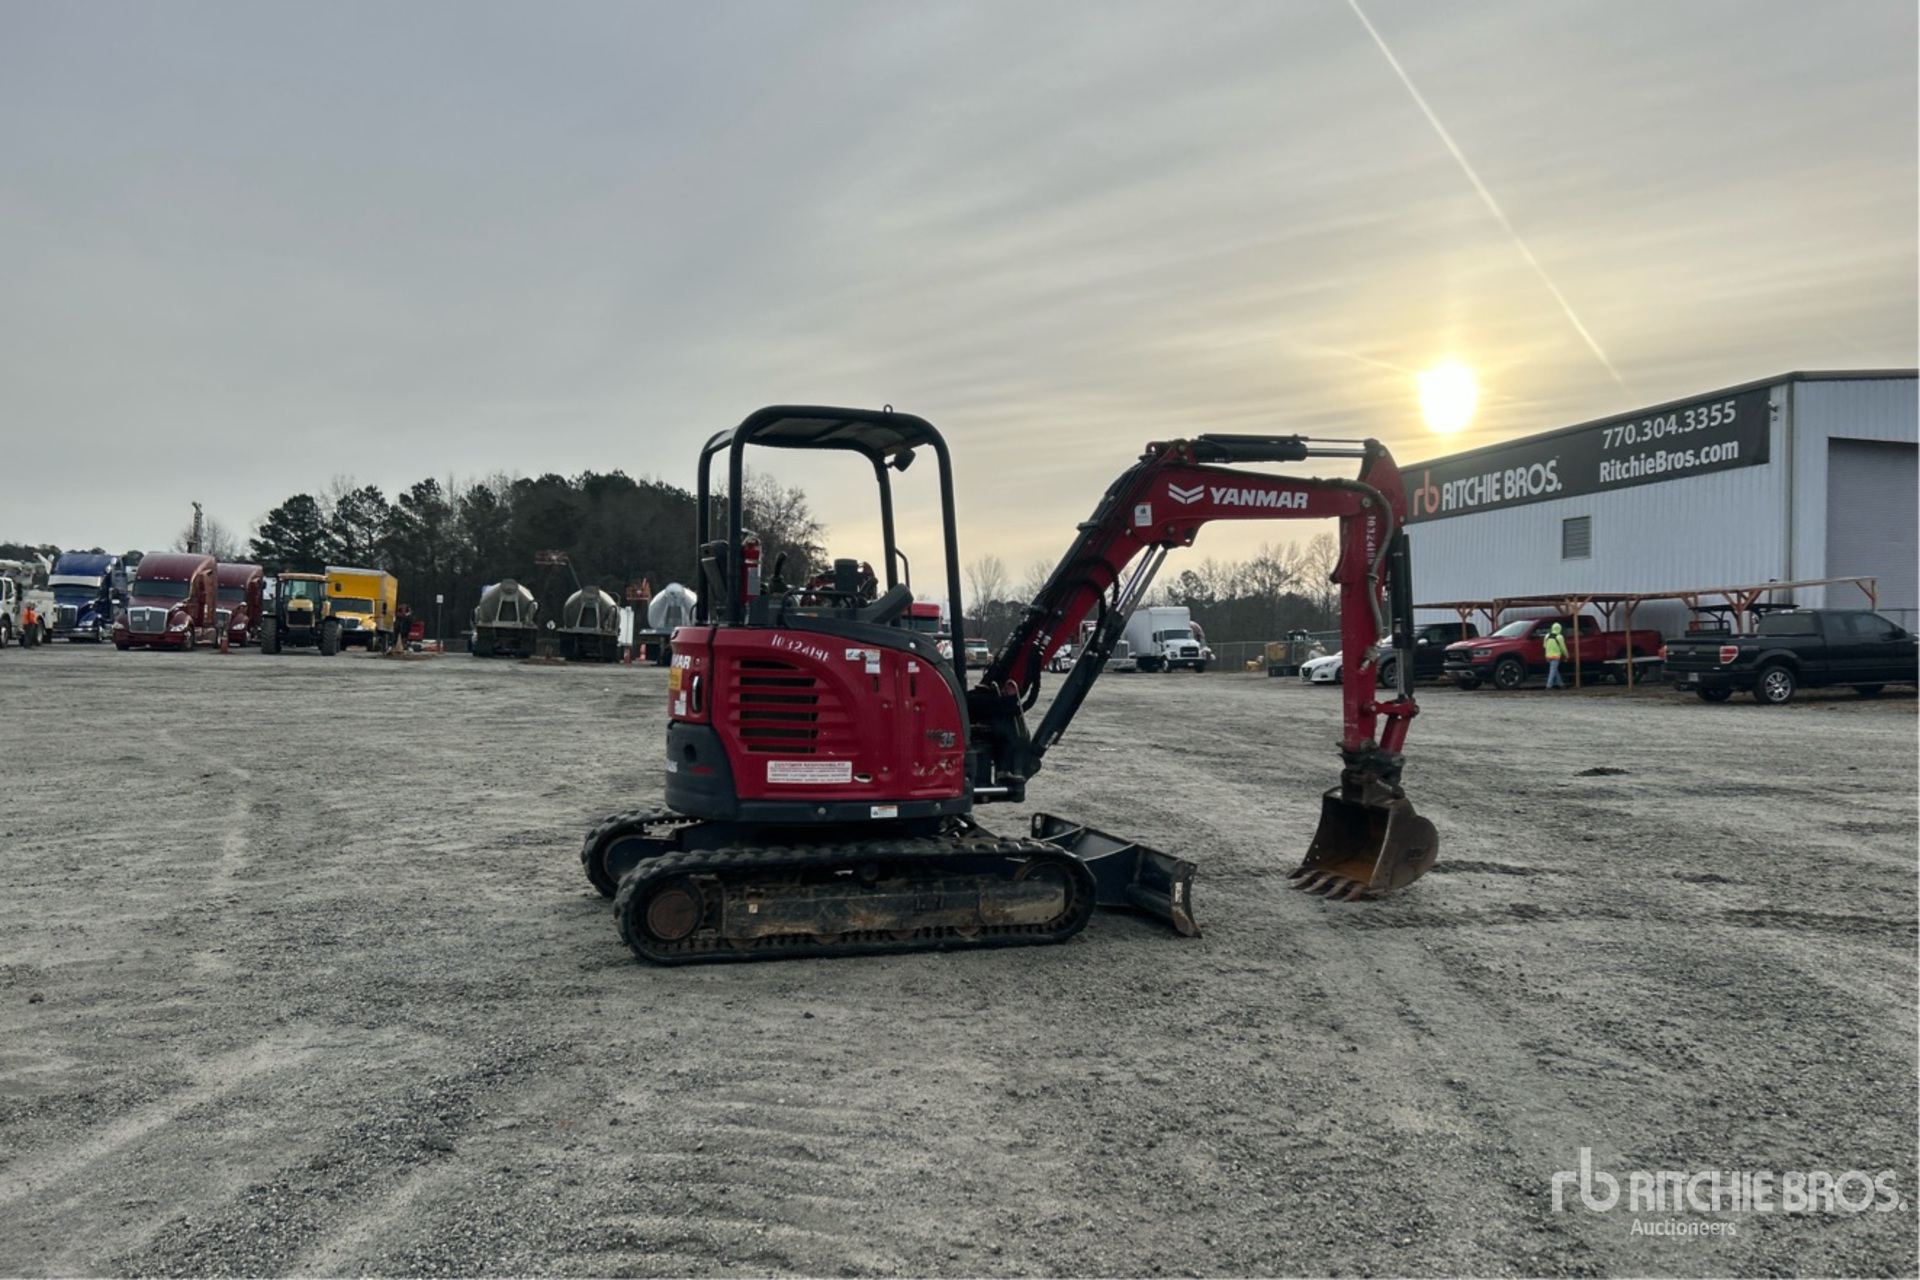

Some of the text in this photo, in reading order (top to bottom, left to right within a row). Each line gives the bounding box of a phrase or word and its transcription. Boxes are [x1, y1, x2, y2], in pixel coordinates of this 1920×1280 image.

[1602, 401, 1736, 449] 770.304.3355
[1599, 440, 1739, 483] RitchieBros.com
[1210, 488, 1309, 509] YANMAR
[1414, 460, 1562, 516] rb RITCHIE BROS.
